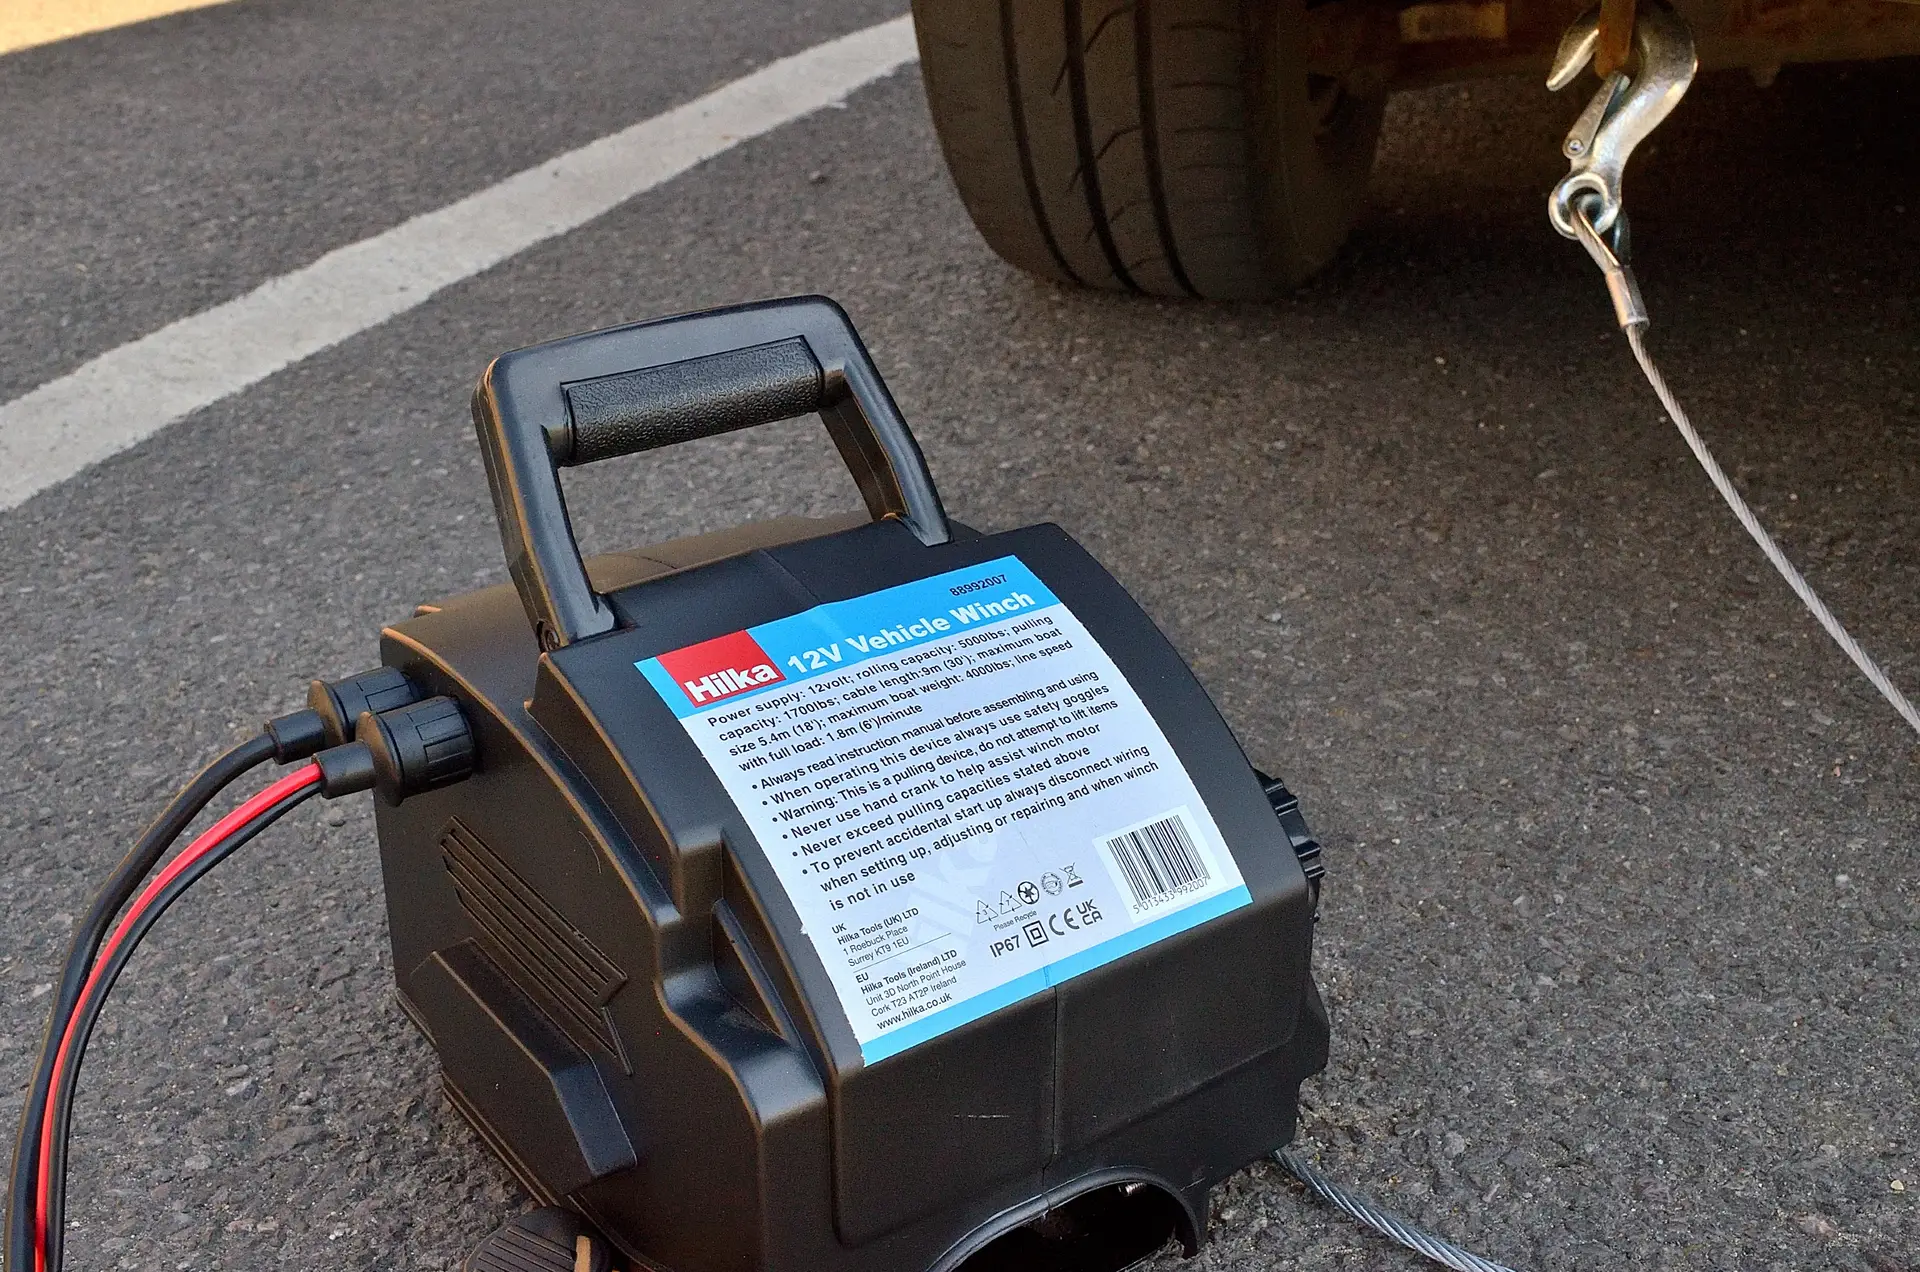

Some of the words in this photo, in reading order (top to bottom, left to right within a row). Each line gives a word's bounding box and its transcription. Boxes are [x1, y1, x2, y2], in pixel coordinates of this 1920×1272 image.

[949, 574, 1008, 597] 88992007
[787, 642, 843, 674] 12V
[844, 617, 953, 654] Vehicle
[948, 591, 1036, 625] Winch
[683, 664, 780, 703] Hilka
[706, 707, 752, 728] Power
[754, 691, 806, 712] supply:
[807, 675, 855, 695] 12volt;
[855, 661, 900, 680] rolling
[900, 644, 958, 666] capacity:
[957, 629, 1011, 649] 5000lbs;
[1010, 616, 1054, 636] pulling
[718, 716, 782, 742] capacity:
[782, 697, 841, 720] 1700lbs;
[842, 684, 878, 702] cable
[976, 637, 1035, 660] maximum
[1033, 627, 1063, 642] boat
[728, 742, 757, 757] size
[757, 730, 792, 747] 5.4m
[826, 698, 890, 724] maximum
[888, 687, 920, 703] boat
[918, 674, 965, 694] weight:
[965, 659, 1016, 679] 4000lbs;
[1013, 652, 1038, 665] line
[1038, 639, 1074, 658] speed
[738, 755, 769, 772] with
[768, 746, 792, 762] full
[790, 736, 826, 754] load:
[825, 726, 859, 742] 1.8m
[760, 768, 807, 790] Always
[806, 755, 836, 774] read
[834, 735, 901, 764] instruction
[900, 718, 946, 741] manual
[943, 708, 983, 726] before
[982, 688, 1047, 714] assembling
[1045, 679, 1068, 694] and
[1066, 671, 1100, 687] using
[769, 785, 812, 805] When
[813, 762, 880, 790] operating
[879, 752, 907, 767] this
[908, 736, 952, 757] device
[953, 721, 998, 742] always
[998, 713, 1023, 727] use
[1023, 700, 1061, 719] safety
[1062, 685, 1110, 708] goggles
[777, 795, 839, 822] Warning:
[836, 785, 868, 801] This
[866, 780, 882, 791] is
[881, 777, 893, 787] a
[891, 760, 937, 786] pulling
[935, 747, 979, 766] device,
[978, 741, 995, 753] do
[994, 732, 1017, 747] not
[1015, 718, 1060, 740] attempt
[1057, 715, 1072, 726] to
[1070, 708, 1089, 721] lift
[1085, 700, 1119, 716] items
[790, 817, 832, 839] Never
[835, 807, 862, 823] use
[861, 792, 899, 813] hand
[900, 778, 940, 800] crank
[939, 773, 956, 785] to
[955, 763, 986, 780] help
[987, 748, 1027, 769] assist
[1026, 735, 1065, 755] winch
[1065, 723, 1101, 742] motor
[800, 834, 842, 857] Never
[845, 813, 895, 840] exceed
[896, 798, 945, 825] pulling
[945, 774, 1011, 804] capacities
[1012, 757, 1053, 780] stated
[1053, 746, 1091, 766] above
[809, 861, 831, 874] To
[832, 839, 885, 870] prevent
[885, 813, 953, 847] accidental
[954, 802, 985, 821] start
[985, 797, 1003, 810] up
[1004, 781, 1047, 803] always
[1047, 757, 1113, 788] disconnect
[1112, 745, 1151, 764] wiring
[819, 872, 859, 893] when
[859, 853, 908, 878] setting
[908, 846, 932, 860] up,
[932, 821, 994, 851] adjusting
[994, 815, 1008, 827] or
[1010, 795, 1067, 822] repairing
[1066, 783, 1091, 801] and
[1090, 774, 1124, 792] when
[1123, 760, 1160, 780] winch
[828, 899, 845, 912] is
[846, 887, 872, 905] not
[871, 882, 888, 895] in
[889, 872, 916, 888] use
[1075, 897, 1098, 916] UK
[831, 922, 848, 934] UK
[836, 932, 861, 946] Hilka
[858, 922, 884, 936] Tools
[883, 913, 903, 929] (UK)
[901, 907, 919, 920] LTD
[992, 919, 1015, 932] Please
[1013, 908, 1038, 924] Recycle
[1048, 907, 1081, 937] CE
[1081, 909, 1104, 927] CA
[842, 947, 849, 956] 1
[849, 933, 887, 954] Roebuck
[884, 925, 909, 940] Place
[847, 951, 875, 967] Surrey
[873, 943, 892, 957] KT9
[891, 936, 910, 949] 1EU
[989, 934, 1020, 958] IP67
[855, 971, 870, 984] EU
[860, 981, 884, 995] Hilka
[882, 971, 907, 985] Tools
[906, 955, 942, 978] (Ireland)
[940, 949, 958, 962] LTD
[865, 992, 884, 1006] Unit
[883, 987, 897, 999] 3D
[896, 978, 920, 994] North
[919, 969, 942, 984] Point
[940, 959, 967, 975] House
[870, 1003, 892, 1017] Cork
[889, 996, 908, 1009] T23
[908, 986, 929, 1003] AT2P
[929, 975, 958, 993] Ireland
[876, 992, 953, 1030] www.hilka.co.uk
